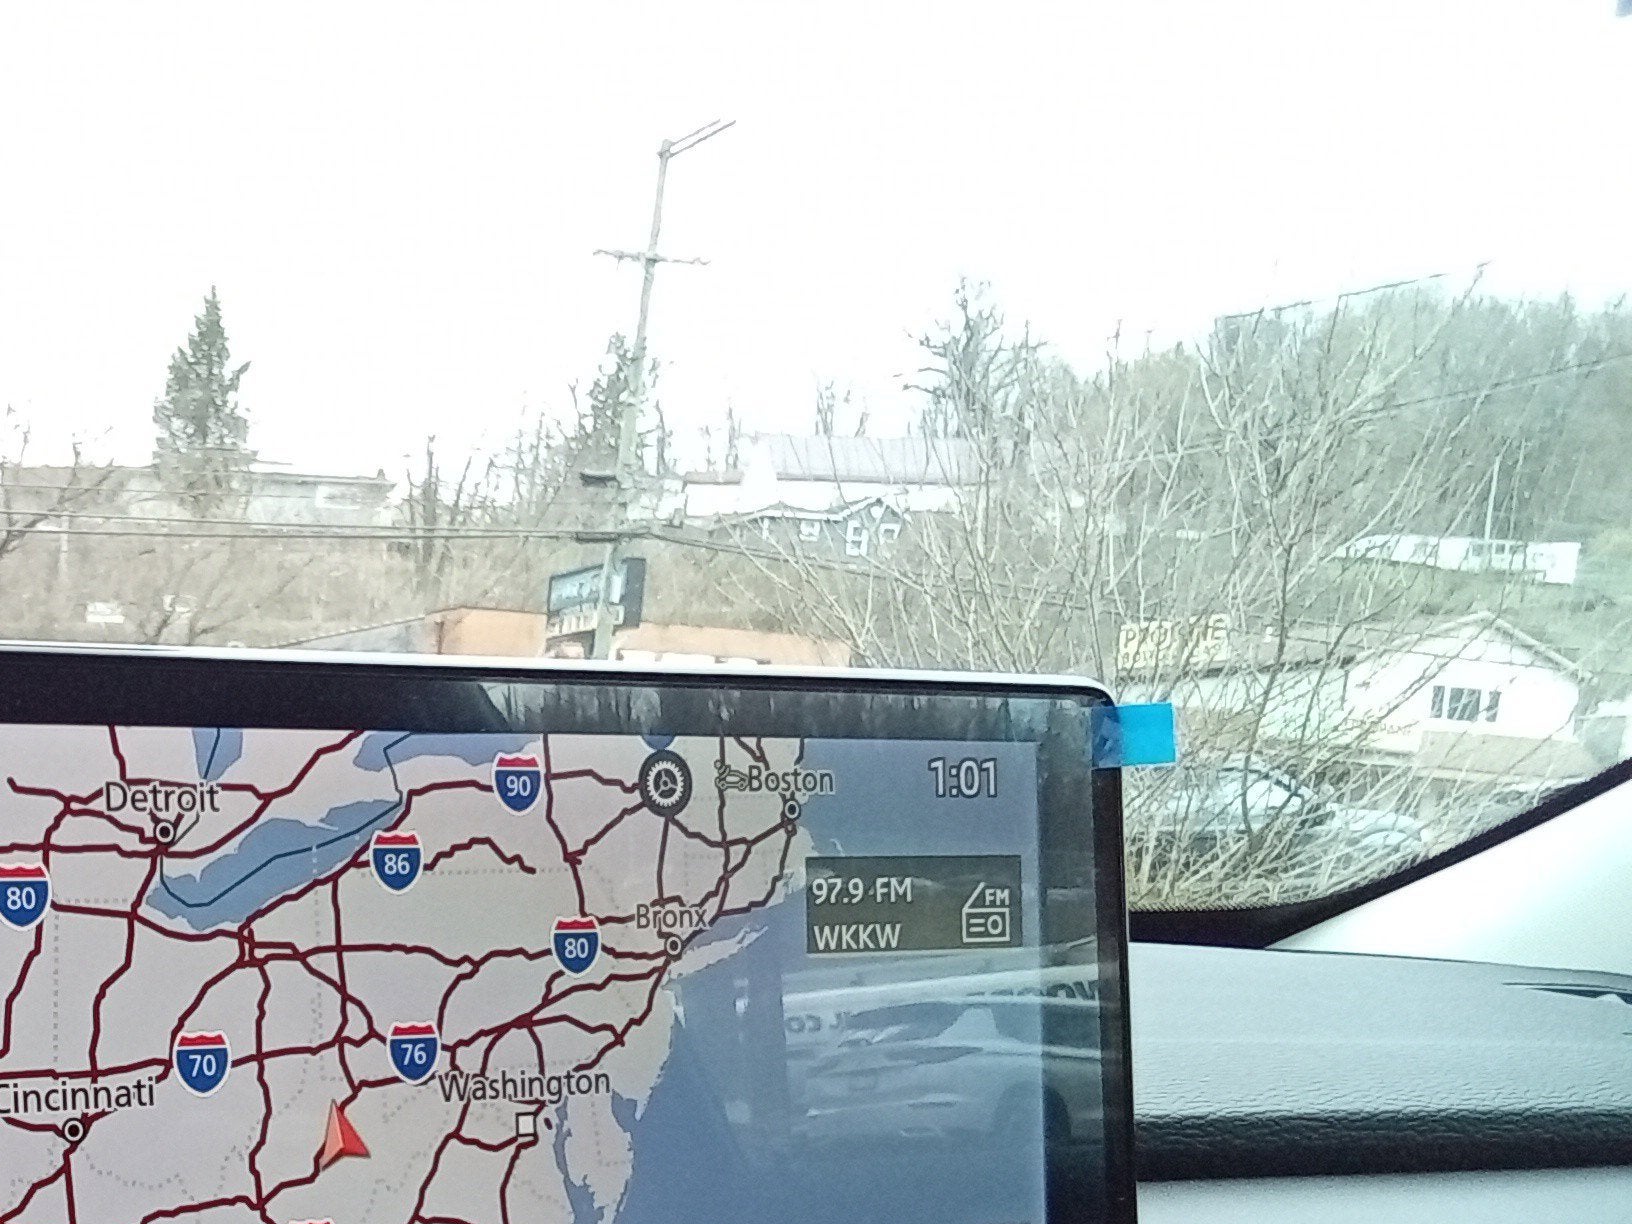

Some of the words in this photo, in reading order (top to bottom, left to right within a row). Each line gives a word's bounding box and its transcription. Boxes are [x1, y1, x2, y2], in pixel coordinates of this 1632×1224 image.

[506, 776, 531, 798] 90
[749, 765, 834, 793] Boston
[929, 758, 997, 797] 1:01
[105, 781, 219, 813] Detroit
[383, 854, 411, 876] 86
[6, 887, 37, 910] 80
[812, 878, 864, 904] 97.9
[875, 877, 912, 903] FM
[985, 888, 1010, 906] FM
[636, 904, 708, 929] Bronx
[813, 923, 902, 950] WKKW
[564, 938, 589, 960] 80
[188, 1055, 217, 1078] 70
[400, 1043, 427, 1066] 76
[438, 1069, 610, 1104] Washington
